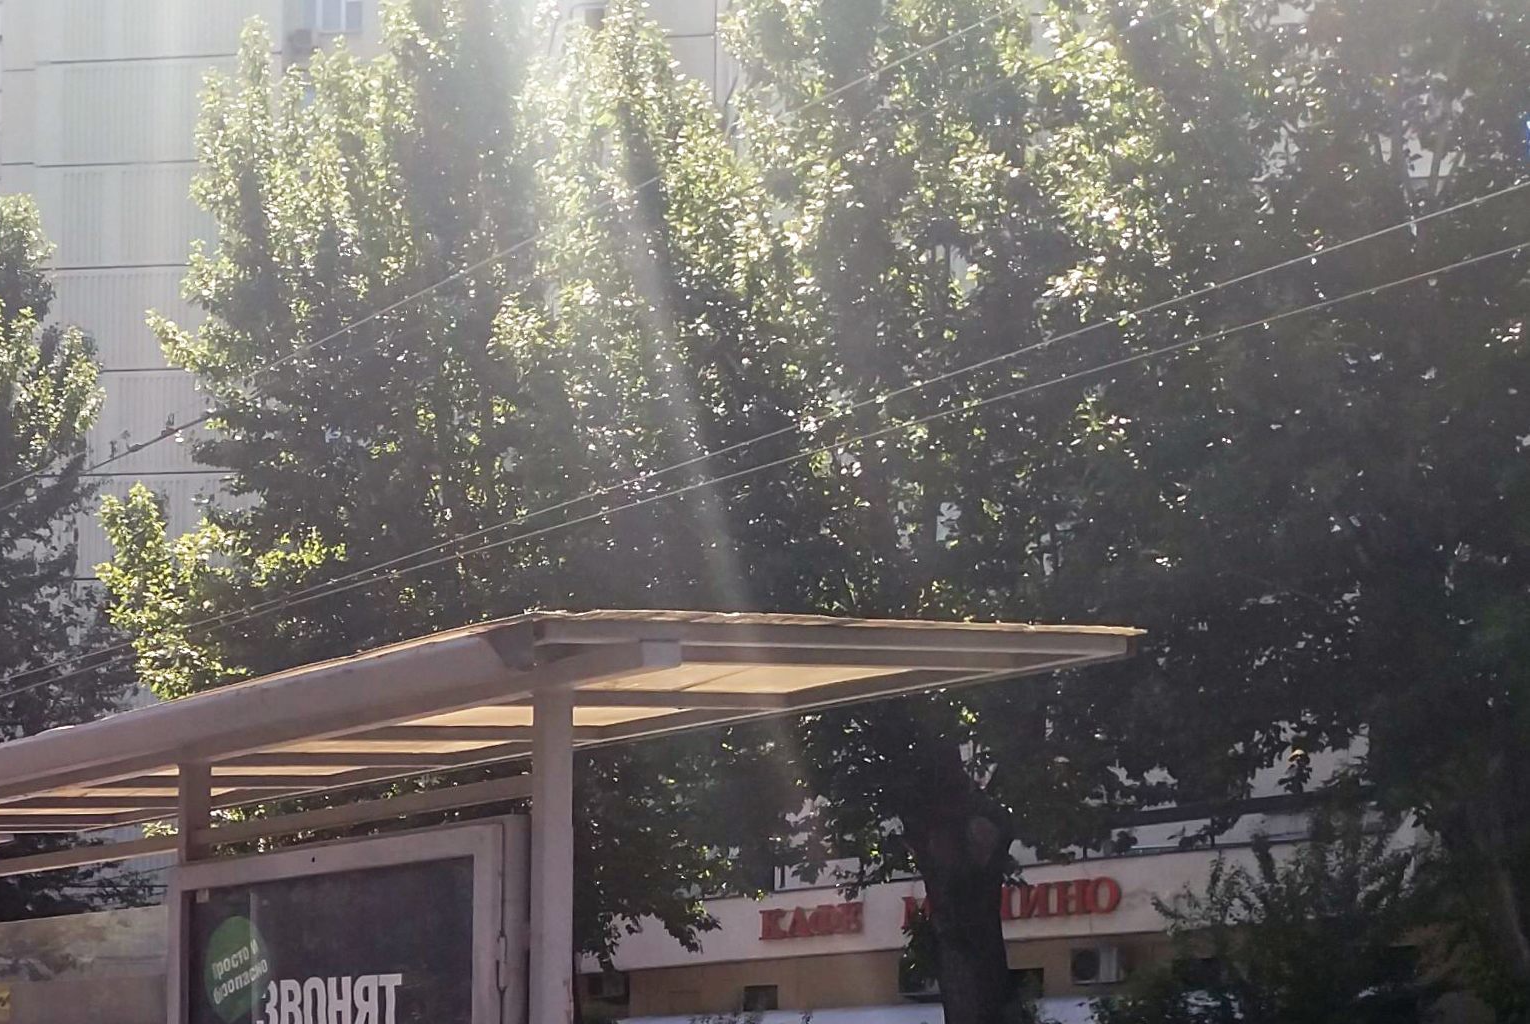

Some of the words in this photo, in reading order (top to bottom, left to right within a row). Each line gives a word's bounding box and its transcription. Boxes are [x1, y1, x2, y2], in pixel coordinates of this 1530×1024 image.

[759, 902, 863, 940] КАФЕ
[900, 877, 1122, 929] МИНО
[212, 946, 250, 979] Просто
[213, 959, 268, 1004] безопасно
